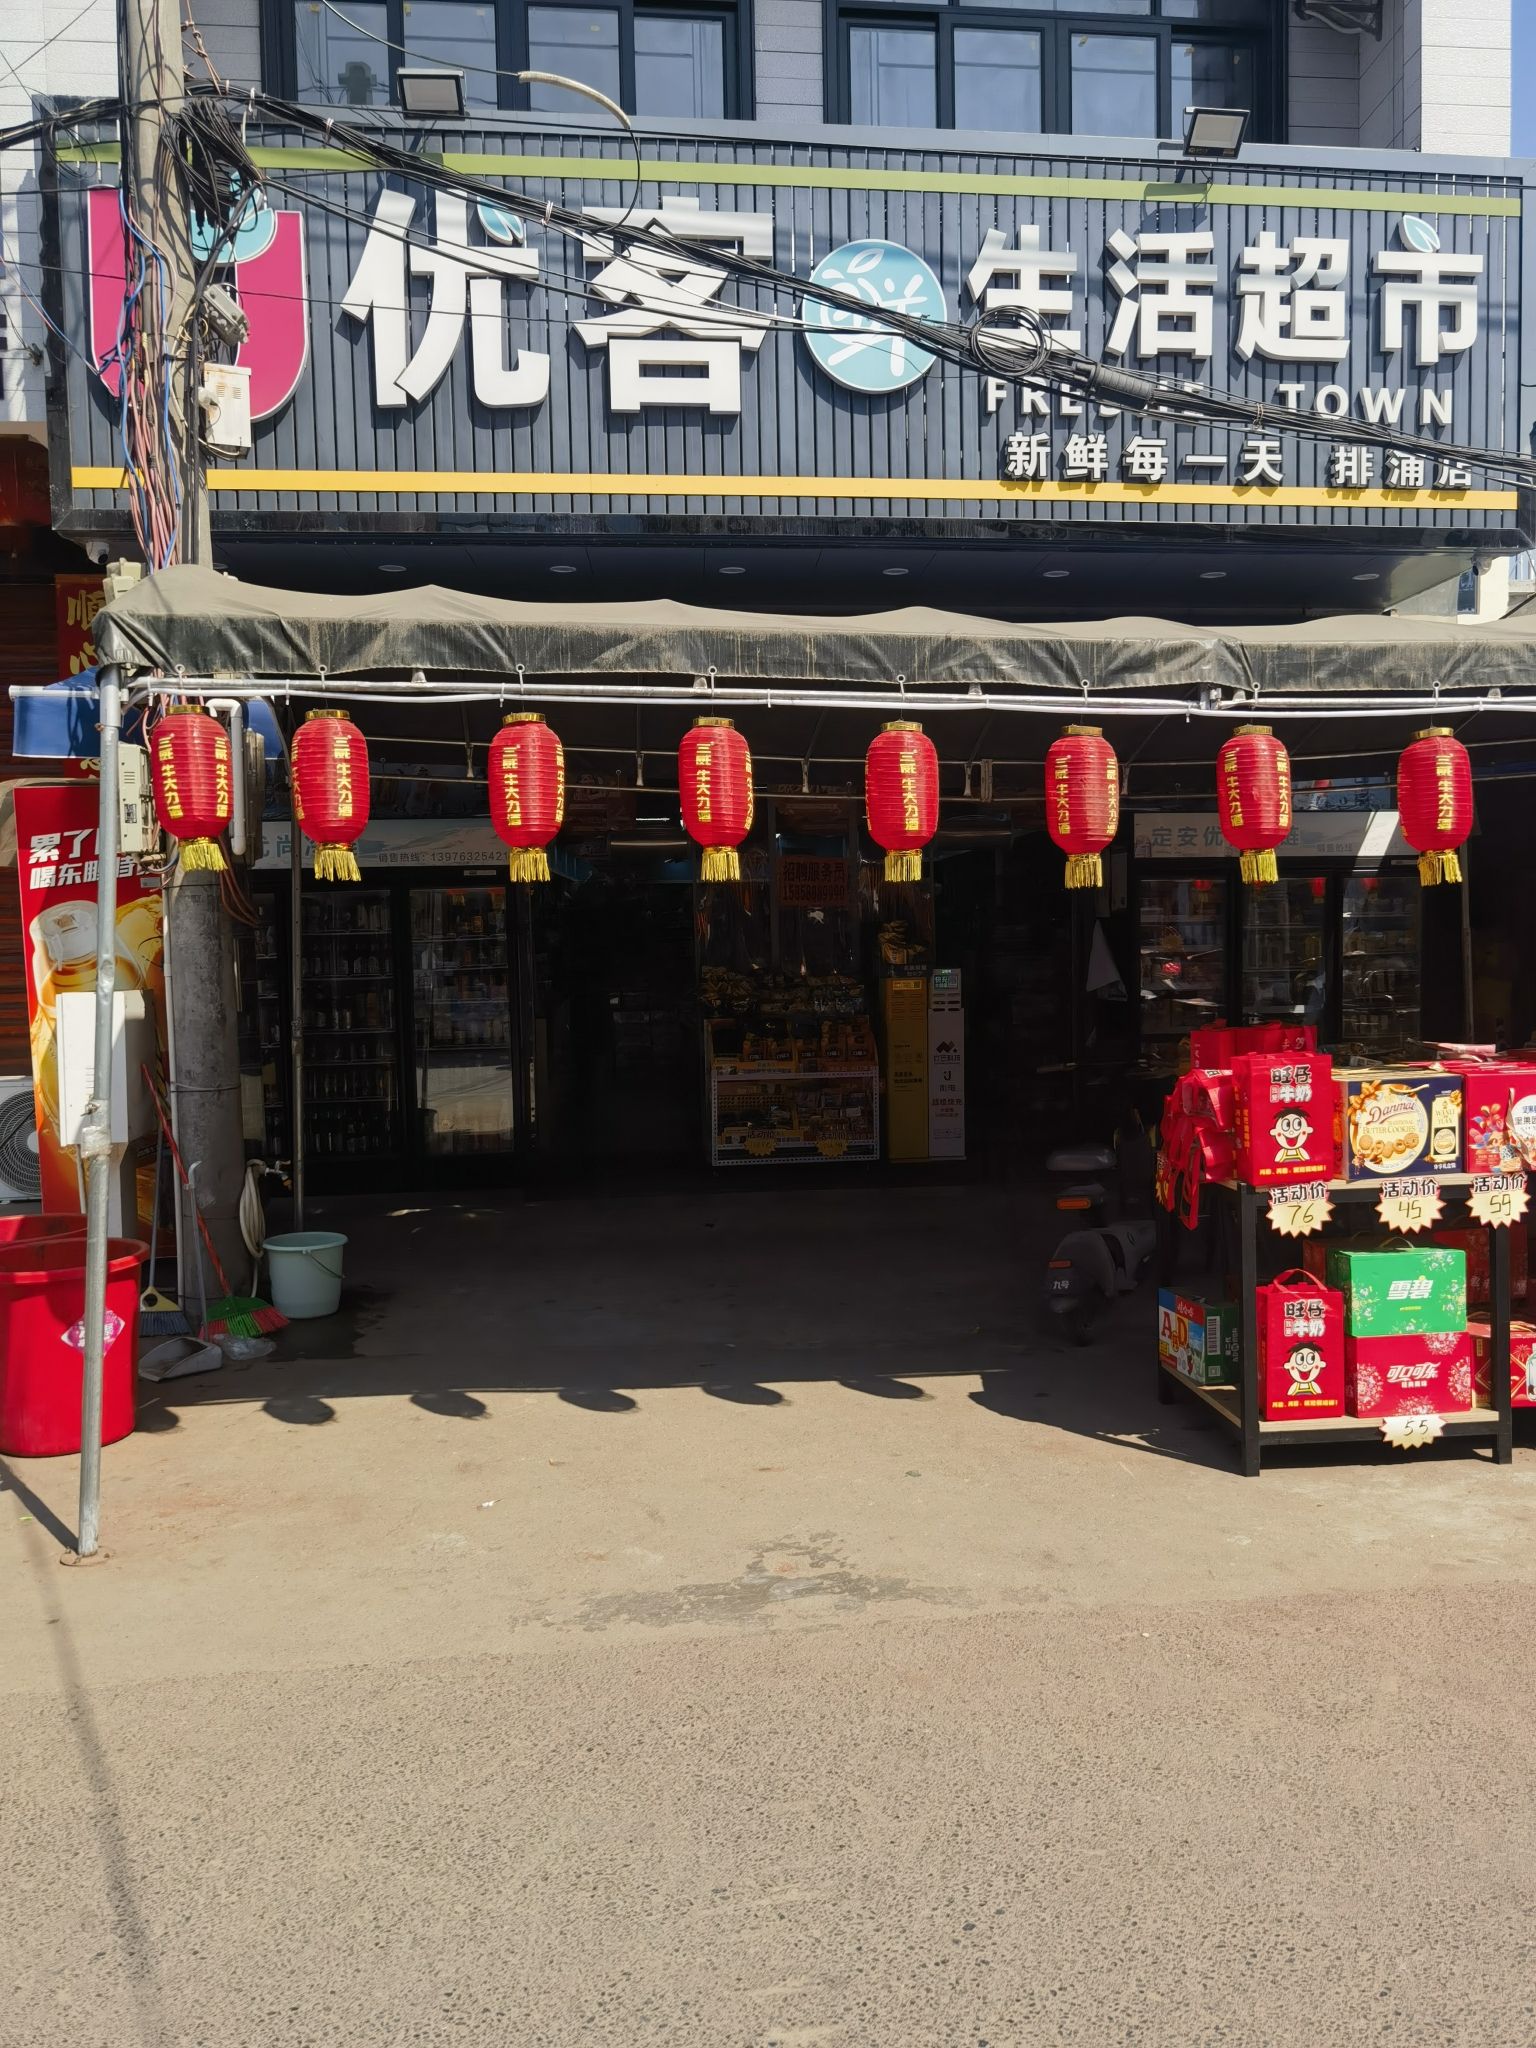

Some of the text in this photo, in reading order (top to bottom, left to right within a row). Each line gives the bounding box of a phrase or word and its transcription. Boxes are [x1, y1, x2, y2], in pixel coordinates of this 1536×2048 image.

[341, 189, 774, 416] 优客
[967, 222, 1484, 366] 生活超市
[1278, 383, 1453, 427] TOWN
[1006, 432, 1284, 485] 新鲜每一天
[28, 827, 101, 864] 累了
[30, 855, 150, 890] 喝东鹏特
[1271, 1064, 1312, 1084] 旺仔
[1279, 1085, 1312, 1103] 牛奶
[1362, 1126, 1387, 1135] BUTTER
[1271, 1183, 1326, 1203] 活动价
[1383, 1181, 1437, 1198] 活动价
[1474, 1174, 1526, 1193] 活动价
[1288, 1203, 1314, 1225] 76
[1399, 1200, 1421, 1219] 45
[1387, 1279, 1433, 1300] 雪碧
[1284, 1299, 1325, 1318] 旺仔
[1293, 1319, 1325, 1337] 牛奶
[1386, 1362, 1441, 1383] 可口可乐
[1403, 1419, 1429, 1436] 55
